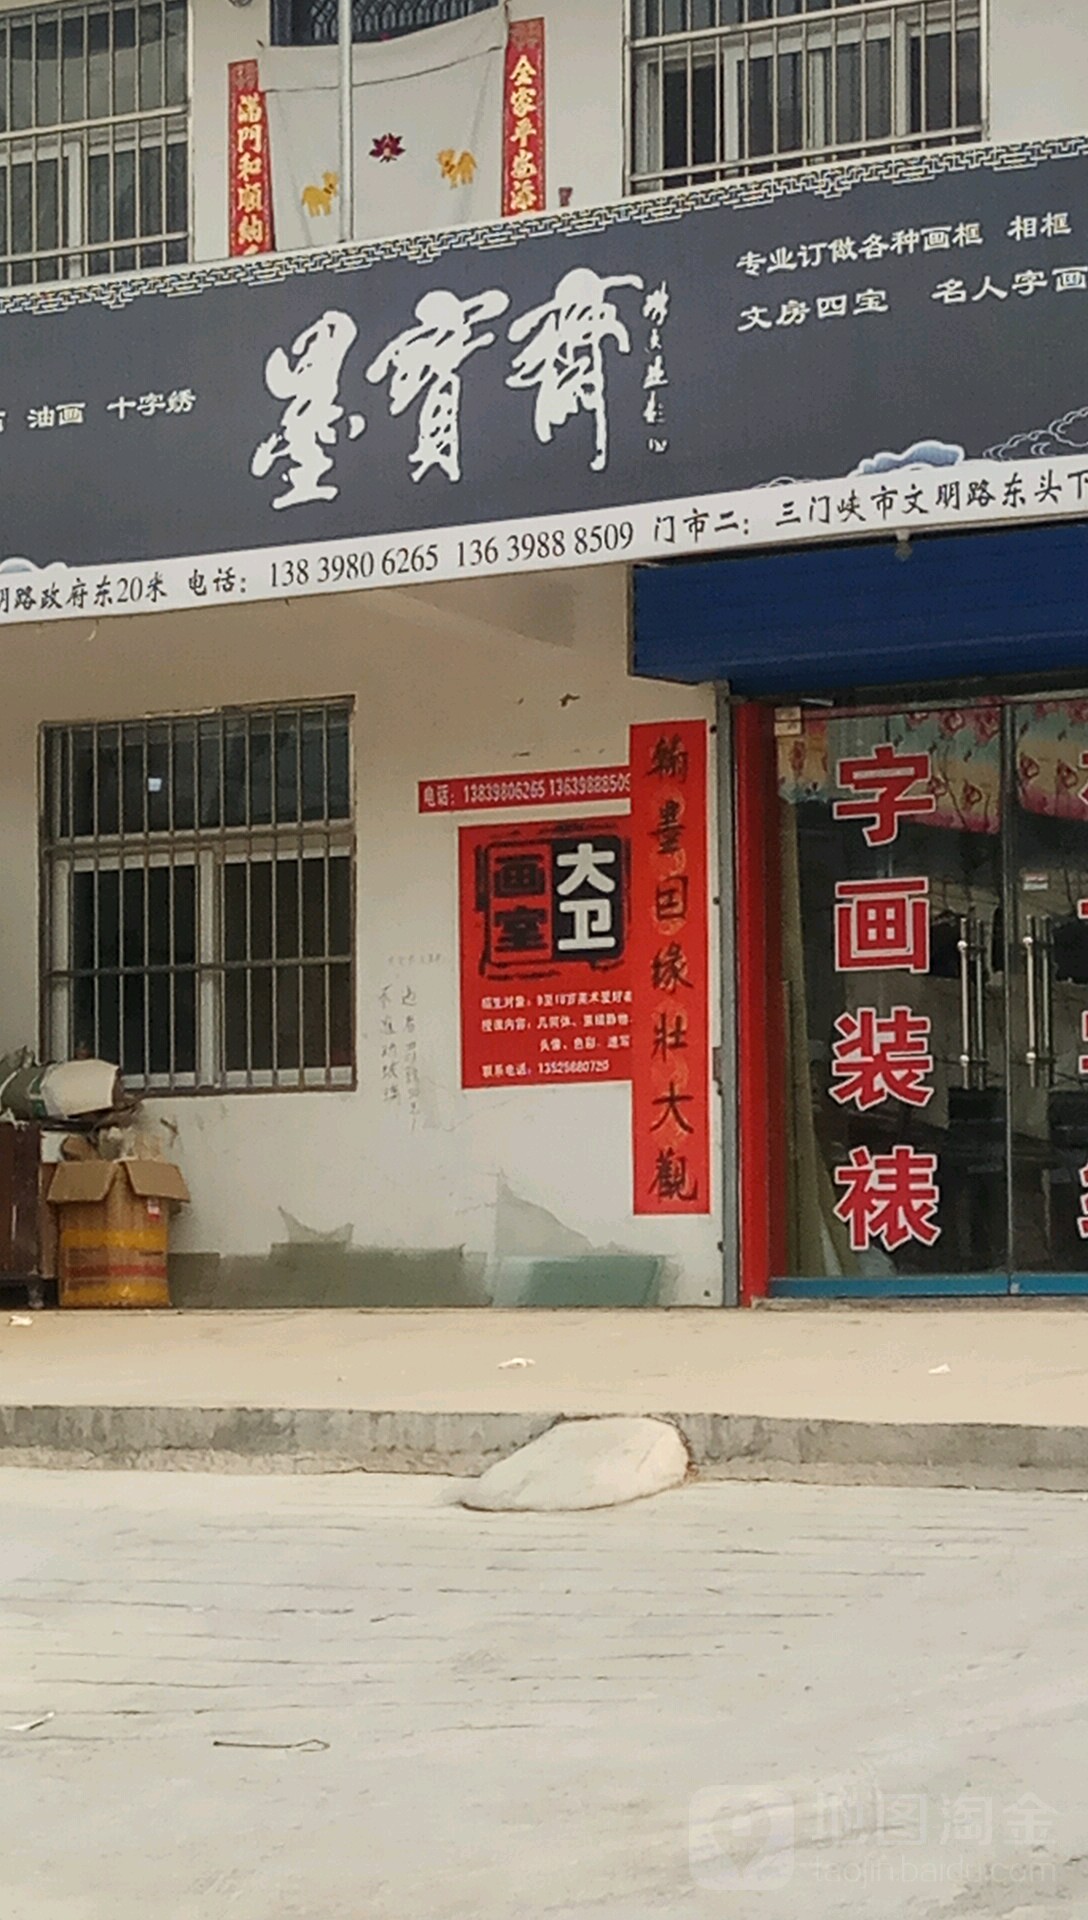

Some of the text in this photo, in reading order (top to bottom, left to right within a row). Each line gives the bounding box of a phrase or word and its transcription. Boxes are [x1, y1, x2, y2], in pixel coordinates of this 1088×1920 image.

[510, 54, 537, 214] 全家平安添
[735, 211, 1073, 278] 专业订做各种画框 相框
[737, 264, 1088, 333] 文房四宝 名人字画
[27, 401, 87, 430] 油画
[106, 388, 197, 421] 十字绣
[186, 565, 249, 599] 电话：
[268, 558, 310, 589] 138
[316, 550, 375, 584] 3980
[380, 542, 440, 576] 6265
[455, 536, 500, 569] 136
[506, 529, 566, 564] 3988
[572, 520, 635, 556] 8509
[653, 509, 751, 544] 门市二：
[494, 853, 550, 953] 画室
[555, 842, 617, 952] 大卫
[828, 744, 940, 1254] 字画装裱
